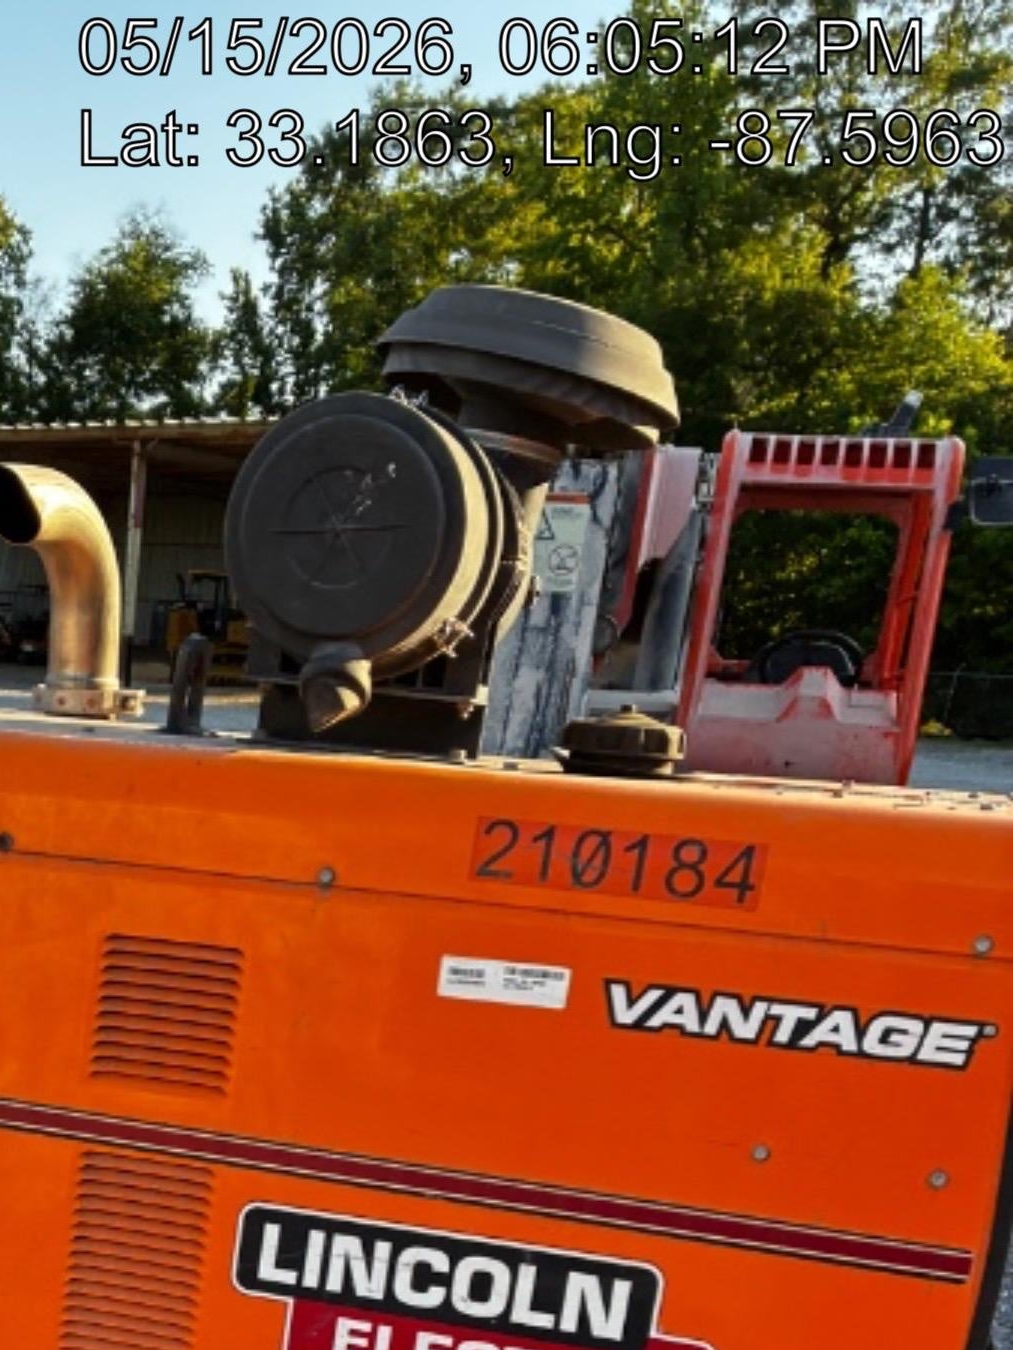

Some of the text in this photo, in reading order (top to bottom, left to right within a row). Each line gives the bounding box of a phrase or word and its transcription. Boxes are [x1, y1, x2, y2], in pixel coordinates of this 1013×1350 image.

[475, 819, 757, 905] 210184
[610, 983, 978, 1066] VANTAGE
[256, 1223, 632, 1342] LINCOLN
